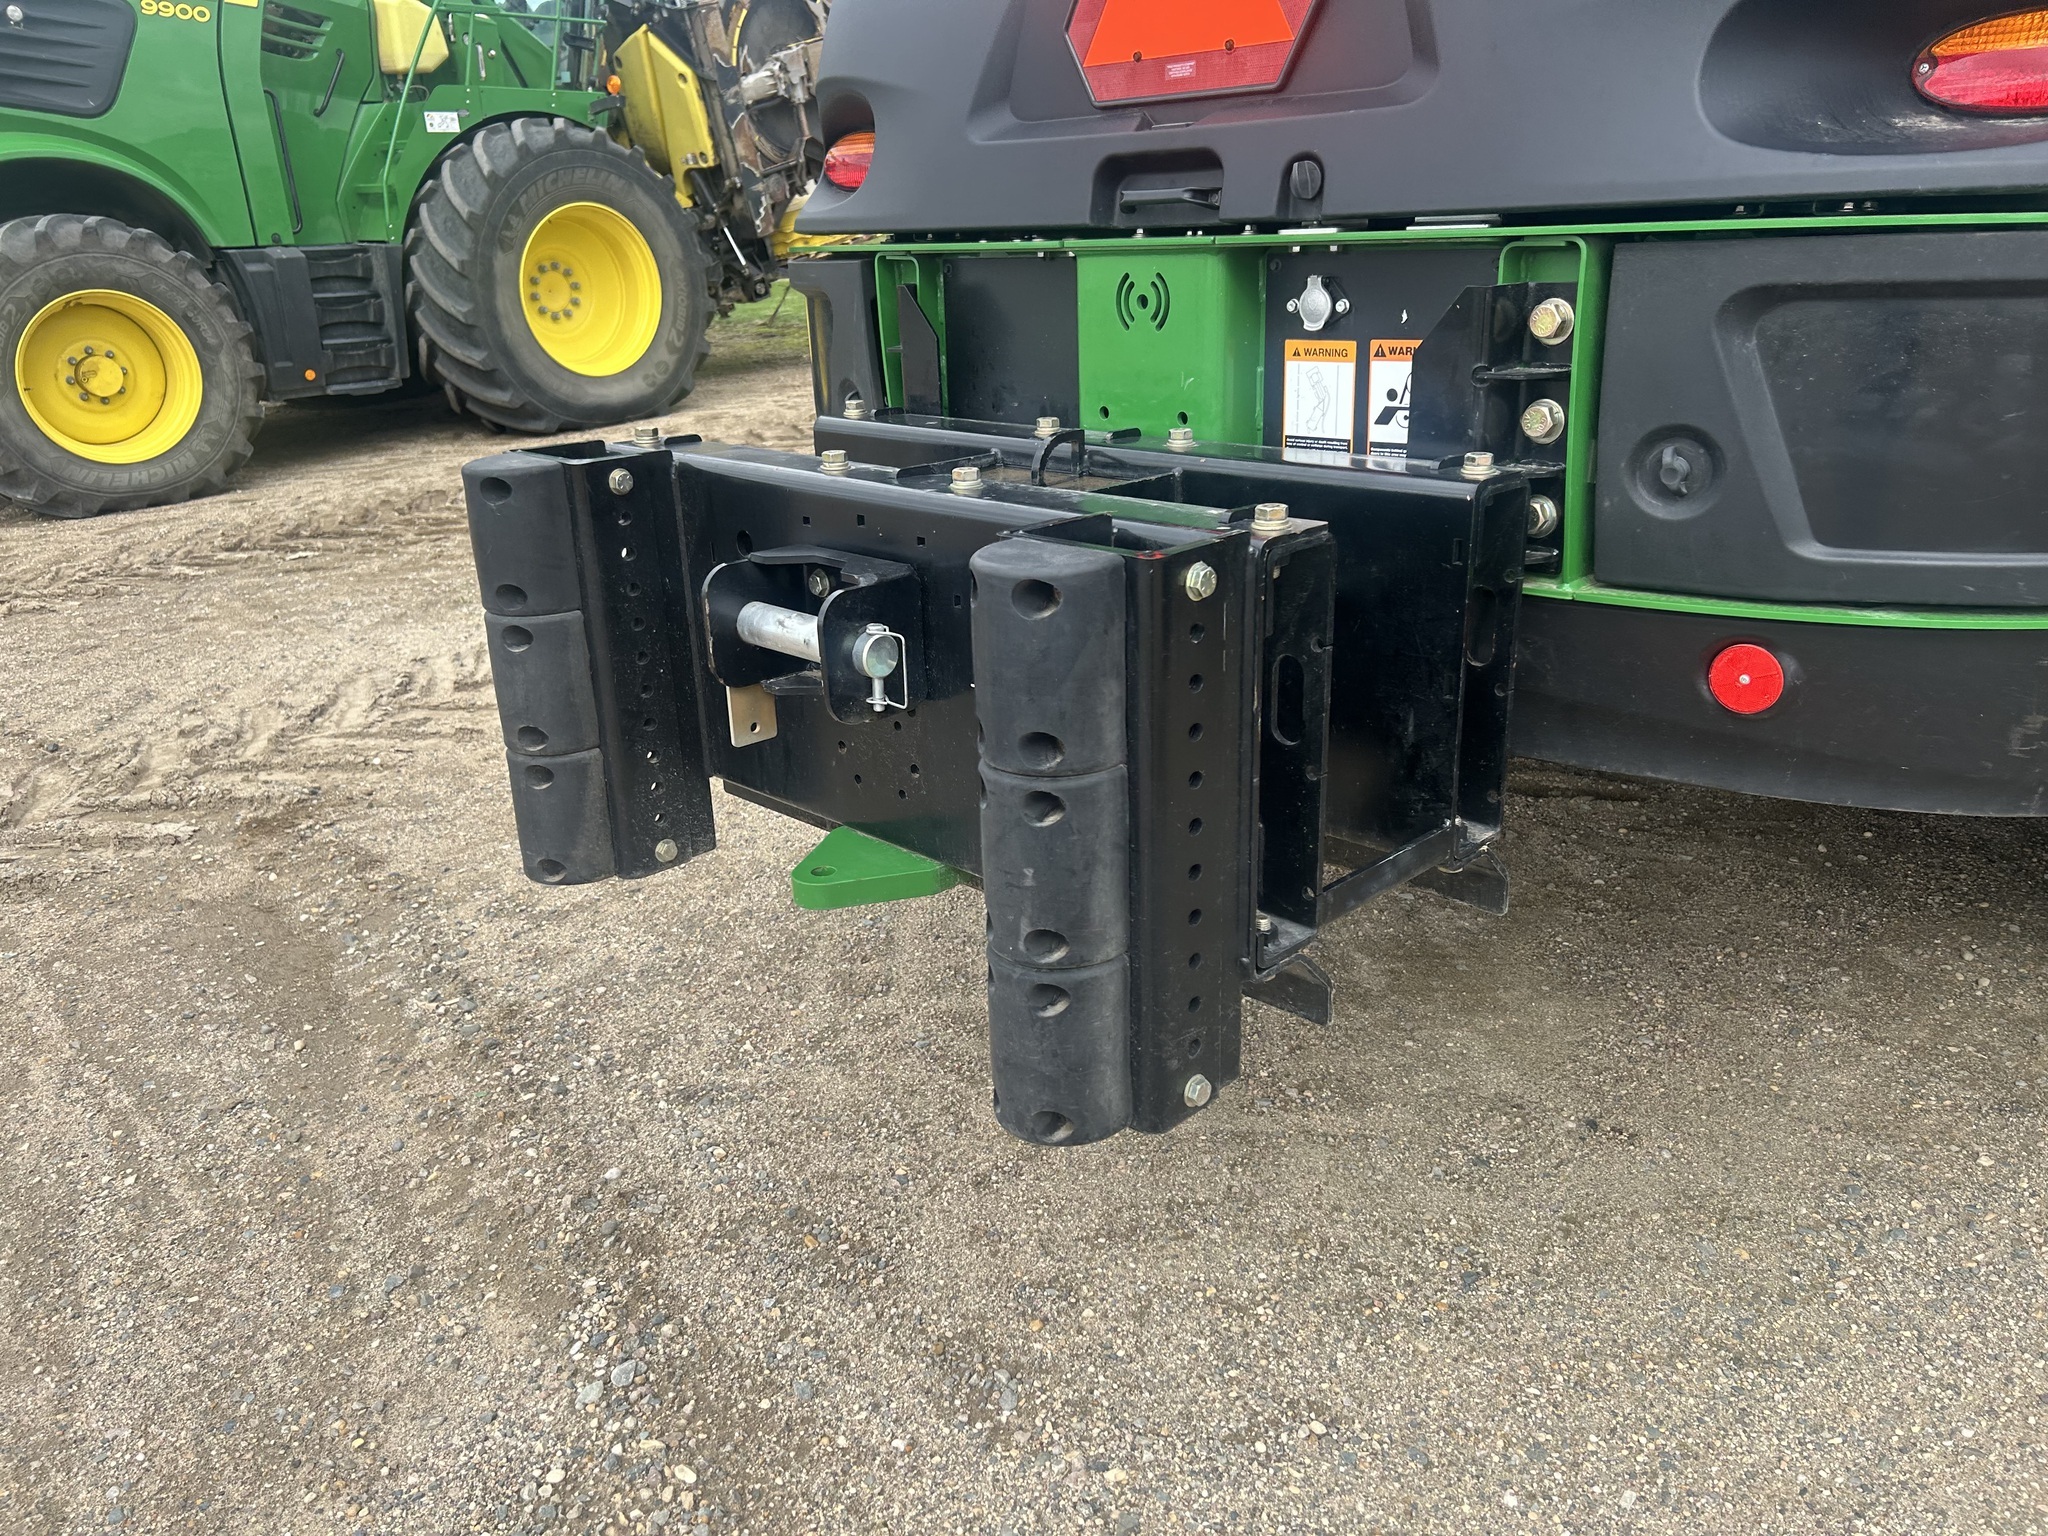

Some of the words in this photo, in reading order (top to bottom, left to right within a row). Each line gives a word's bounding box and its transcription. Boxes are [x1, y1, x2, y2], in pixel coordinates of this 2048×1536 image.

[140, 0, 211, 22] 9900
[519, 167, 630, 215] MICHELIN
[1303, 347, 1348, 358] WARNING
[62, 451, 197, 488] MICHELIN
